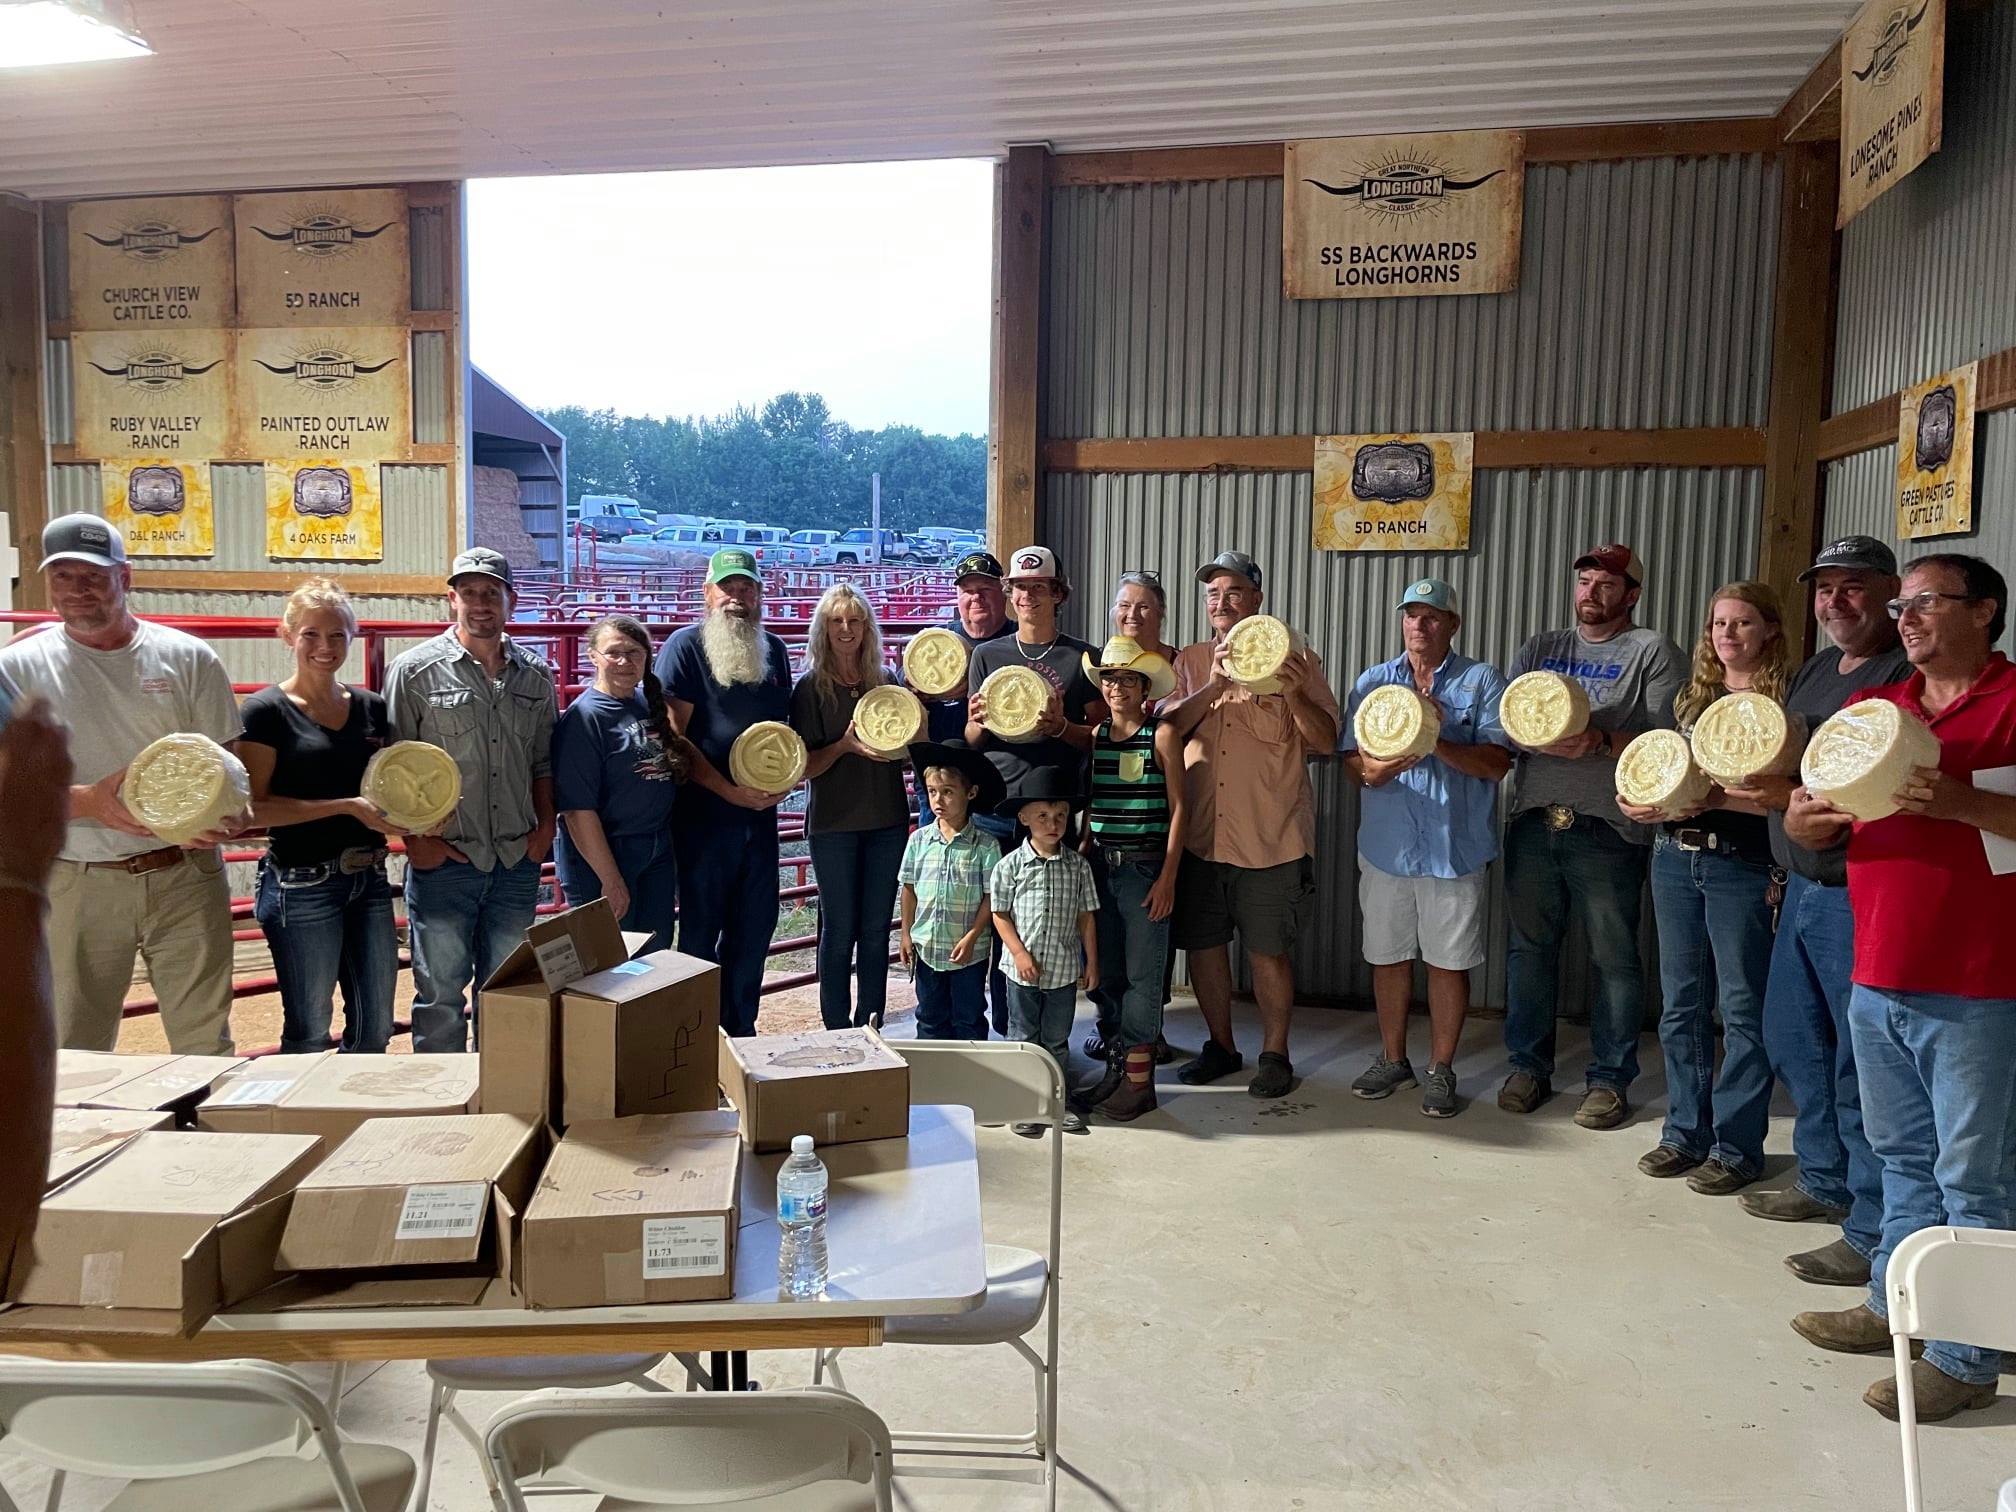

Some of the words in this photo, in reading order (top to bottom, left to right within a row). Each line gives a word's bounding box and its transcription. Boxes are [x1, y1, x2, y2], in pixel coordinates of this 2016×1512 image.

[1850, 116, 1895, 178] LONESOME
[1897, 91, 1923, 137] PINES
[1378, 166, 1396, 177] GREAT
[1398, 163, 1430, 174] NORTHERN
[1868, 144, 1898, 187] RANCH
[1363, 177, 1444, 200] LONGHORN
[1388, 203, 1416, 212] CLASSIC
[294, 227, 353, 245] LONGHORN
[1321, 247, 1343, 266] SS
[1350, 241, 1477, 265] BACKWARDS
[1335, 264, 1460, 287] LONGHORNS
[102, 287, 160, 303] CHURCH
[164, 286, 200, 301] VIEW
[286, 293, 304, 308] 5D
[308, 292, 360, 308] RANCH
[113, 305, 164, 321] CATTLE
[168, 304, 192, 319] CO.
[127, 363, 183, 380] LONGHORN
[296, 361, 355, 379] LONGHORN
[110, 417, 145, 432] RUBY
[150, 416, 202, 431] VALLEY
[261, 416, 321, 432] PAINTED
[326, 416, 390, 432] OUTLAW
[132, 434, 180, 449] RANCH
[299, 435, 350, 450] RANCH
[1900, 489, 1925, 508] GREEN
[1925, 480, 1955, 503] PASTURES
[1909, 506, 1933, 526] CATTLE
[1934, 504, 1944, 522] CO.
[1354, 521, 1373, 535] 5D
[1377, 520, 1427, 535] RANCH
[130, 530, 148, 542] D&L
[152, 530, 186, 542] RANCH
[290, 534, 296, 544] 4
[299, 533, 327, 545] OAKS
[330, 533, 356, 545] FARM
[406, 1211, 428, 1219] 11.21
[649, 1247, 672, 1257] 11.73
